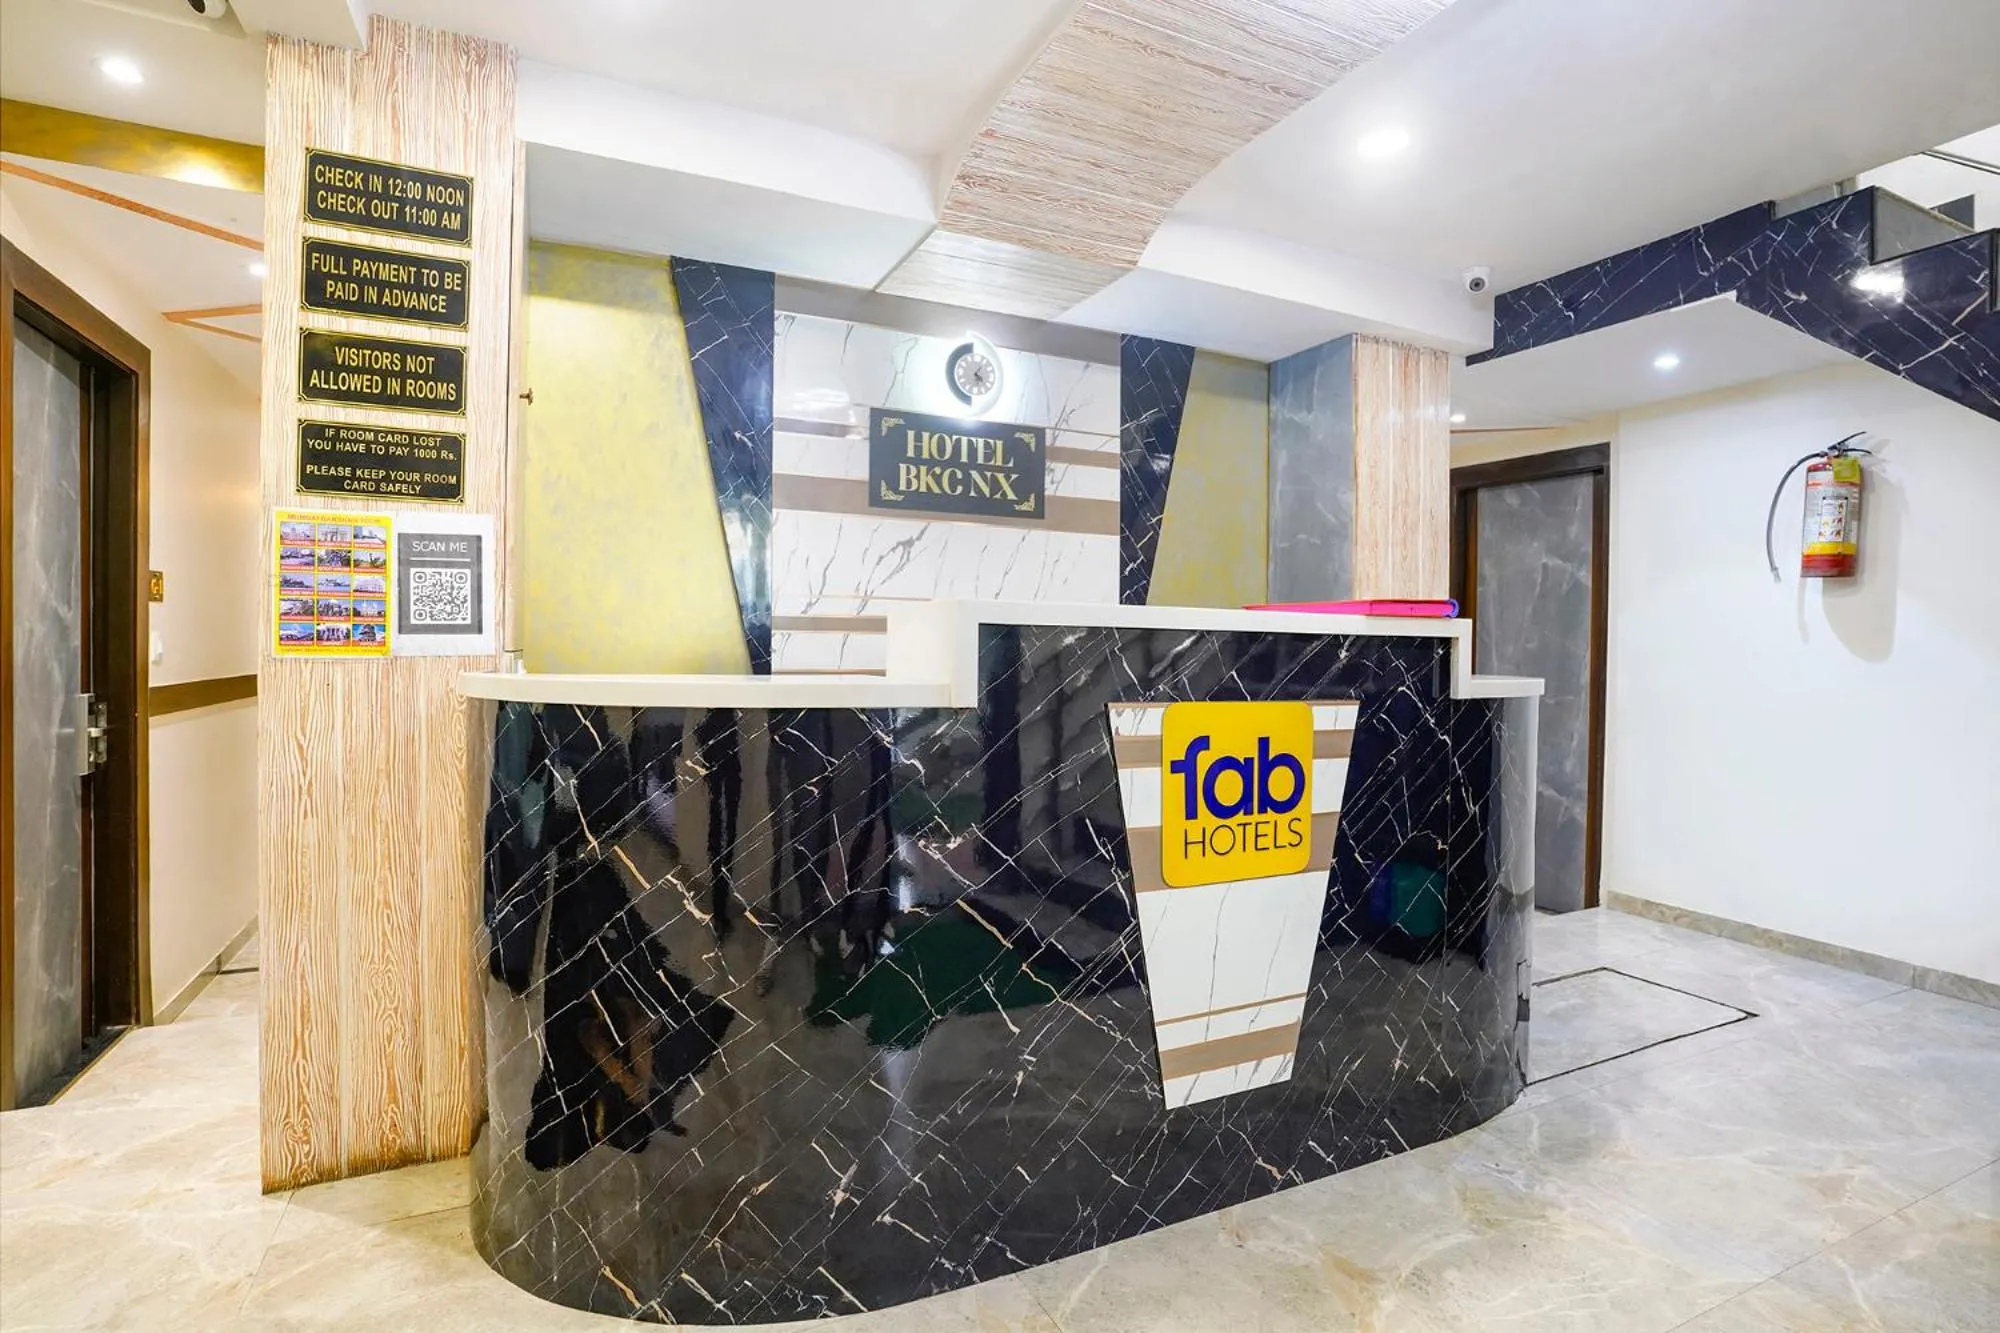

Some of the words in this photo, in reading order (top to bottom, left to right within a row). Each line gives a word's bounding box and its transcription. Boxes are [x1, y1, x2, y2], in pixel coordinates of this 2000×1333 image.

[315, 164, 364, 191] CHECK
[368, 173, 383, 193] IN
[388, 177, 422, 200] 12:00
[426, 184, 465, 207] NOON
[316, 190, 366, 216] CHECK
[371, 199, 399, 221] OUT
[405, 205, 437, 227] 11:00
[441, 211, 461, 231] AM
[311, 252, 347, 275] FULL
[352, 258, 417, 285] PAYMENT
[421, 268, 439, 288] TO
[444, 272, 462, 291] BE
[326, 280, 359, 301] PAID
[364, 285, 378, 305] IN
[382, 288, 447, 313] ADVANCE
[335, 346, 401, 371] VISITORS
[406, 355, 435, 375] NOT
[309, 369, 382, 394] ALLOWED
[387, 378, 401, 396] IN
[406, 379, 457, 401] ROOMS
[307, 438, 332, 450] YOU
[336, 442, 366, 454] HAVE
[371, 444, 385, 455] TO
[389, 445, 410, 456] PAY
[414, 448, 437, 459] 1000
[441, 449, 457, 461] Rs.
[325, 428, 336, 438] IF
[340, 429, 374, 441] ROOM
[378, 432, 409, 444] CARD
[413, 435, 442, 447] LOST
[906, 429, 1014, 468] HOTEL
[306, 464, 352, 477] PLEASE
[356, 468, 386, 480] KEEP
[389, 471, 420, 482] YOUR
[424, 473, 457, 485] ROOM
[344, 479, 376, 491] CARD
[380, 482, 422, 494] SAFELY
[898, 463, 963, 496] BKC
[969, 469, 1019, 500] NX
[412, 541, 446, 553] SCAN
[449, 541, 468, 553] ME
[1170, 735, 1305, 820] fab
[1184, 817, 1304, 859] HOTELS
